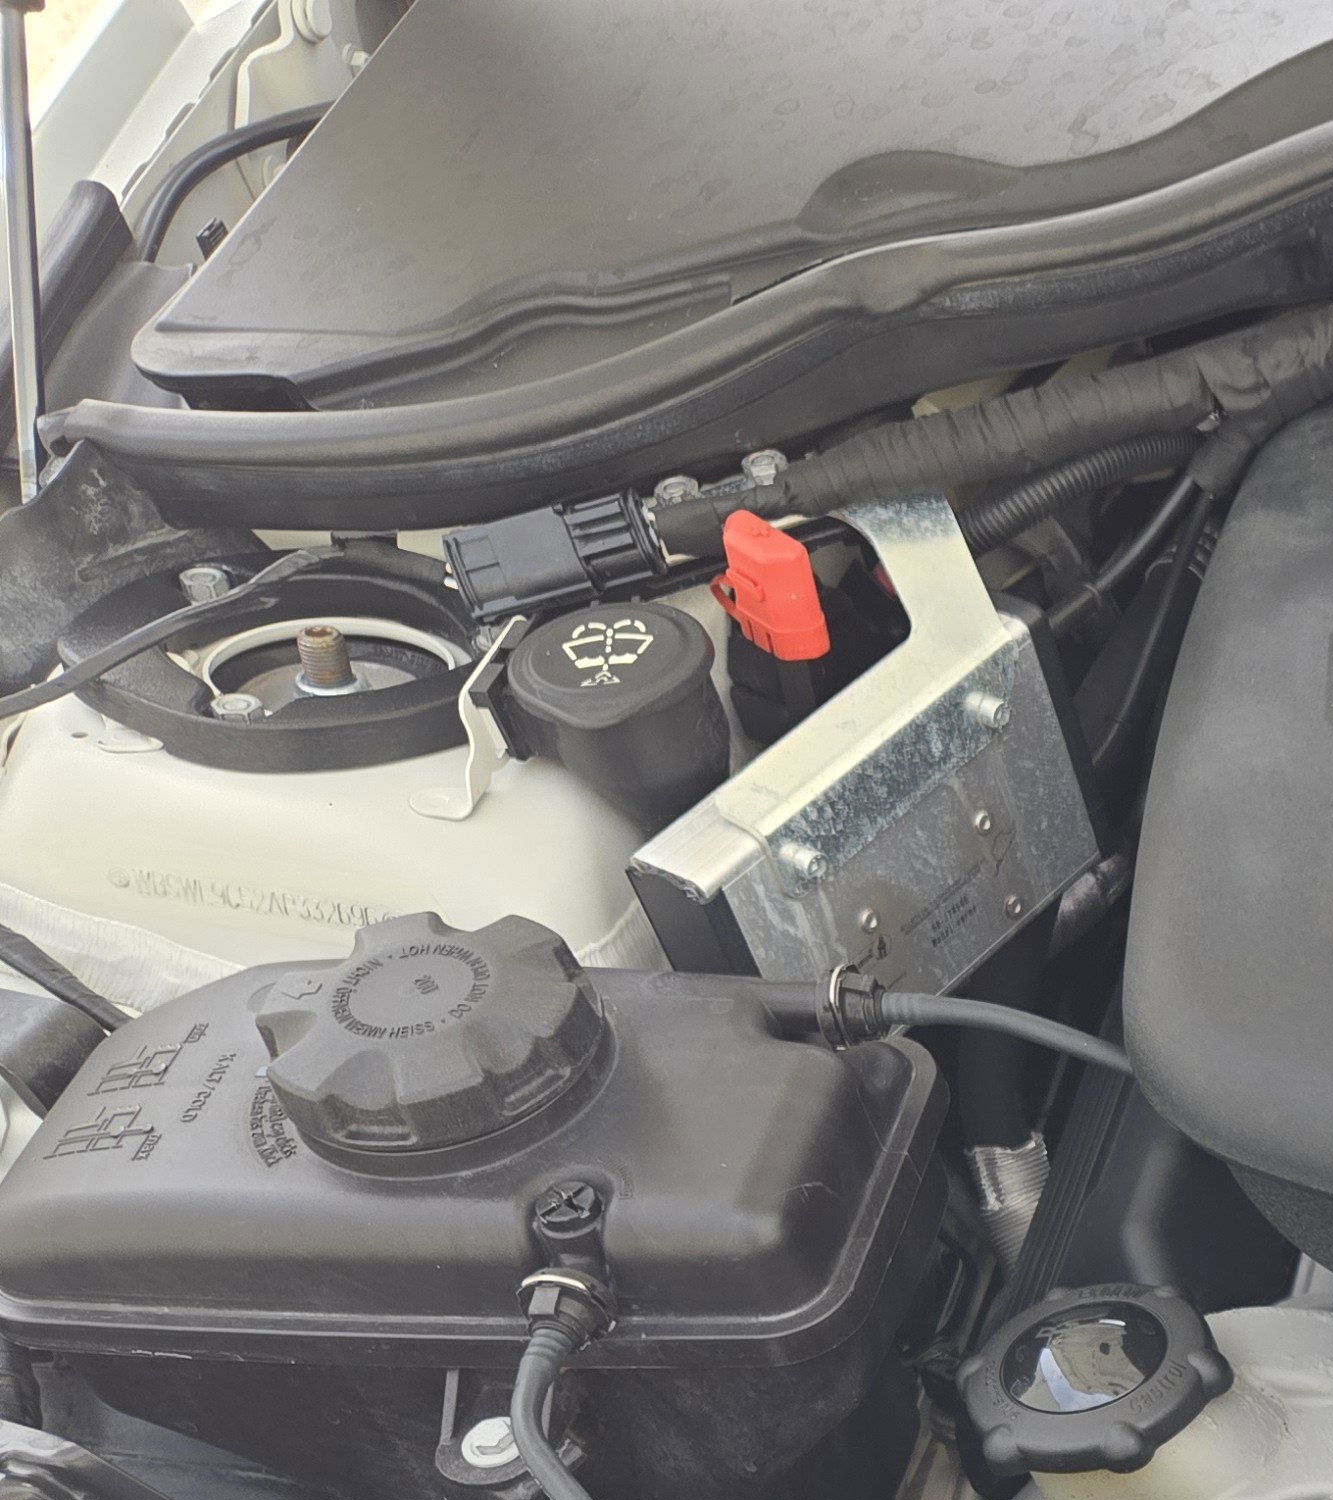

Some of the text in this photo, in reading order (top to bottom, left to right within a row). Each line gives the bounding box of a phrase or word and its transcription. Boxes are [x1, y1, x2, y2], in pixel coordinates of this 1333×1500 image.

[400, 944, 432, 959] HOT
[342, 957, 384, 987] NICHT
[389, 1020, 435, 1040] HEISS
[447, 1003, 473, 1019] DO
[463, 982, 490, 1003] NOT
[179, 1052, 237, 1124] KALT/COLD
[1130, 1359, 1188, 1414] Castrol
